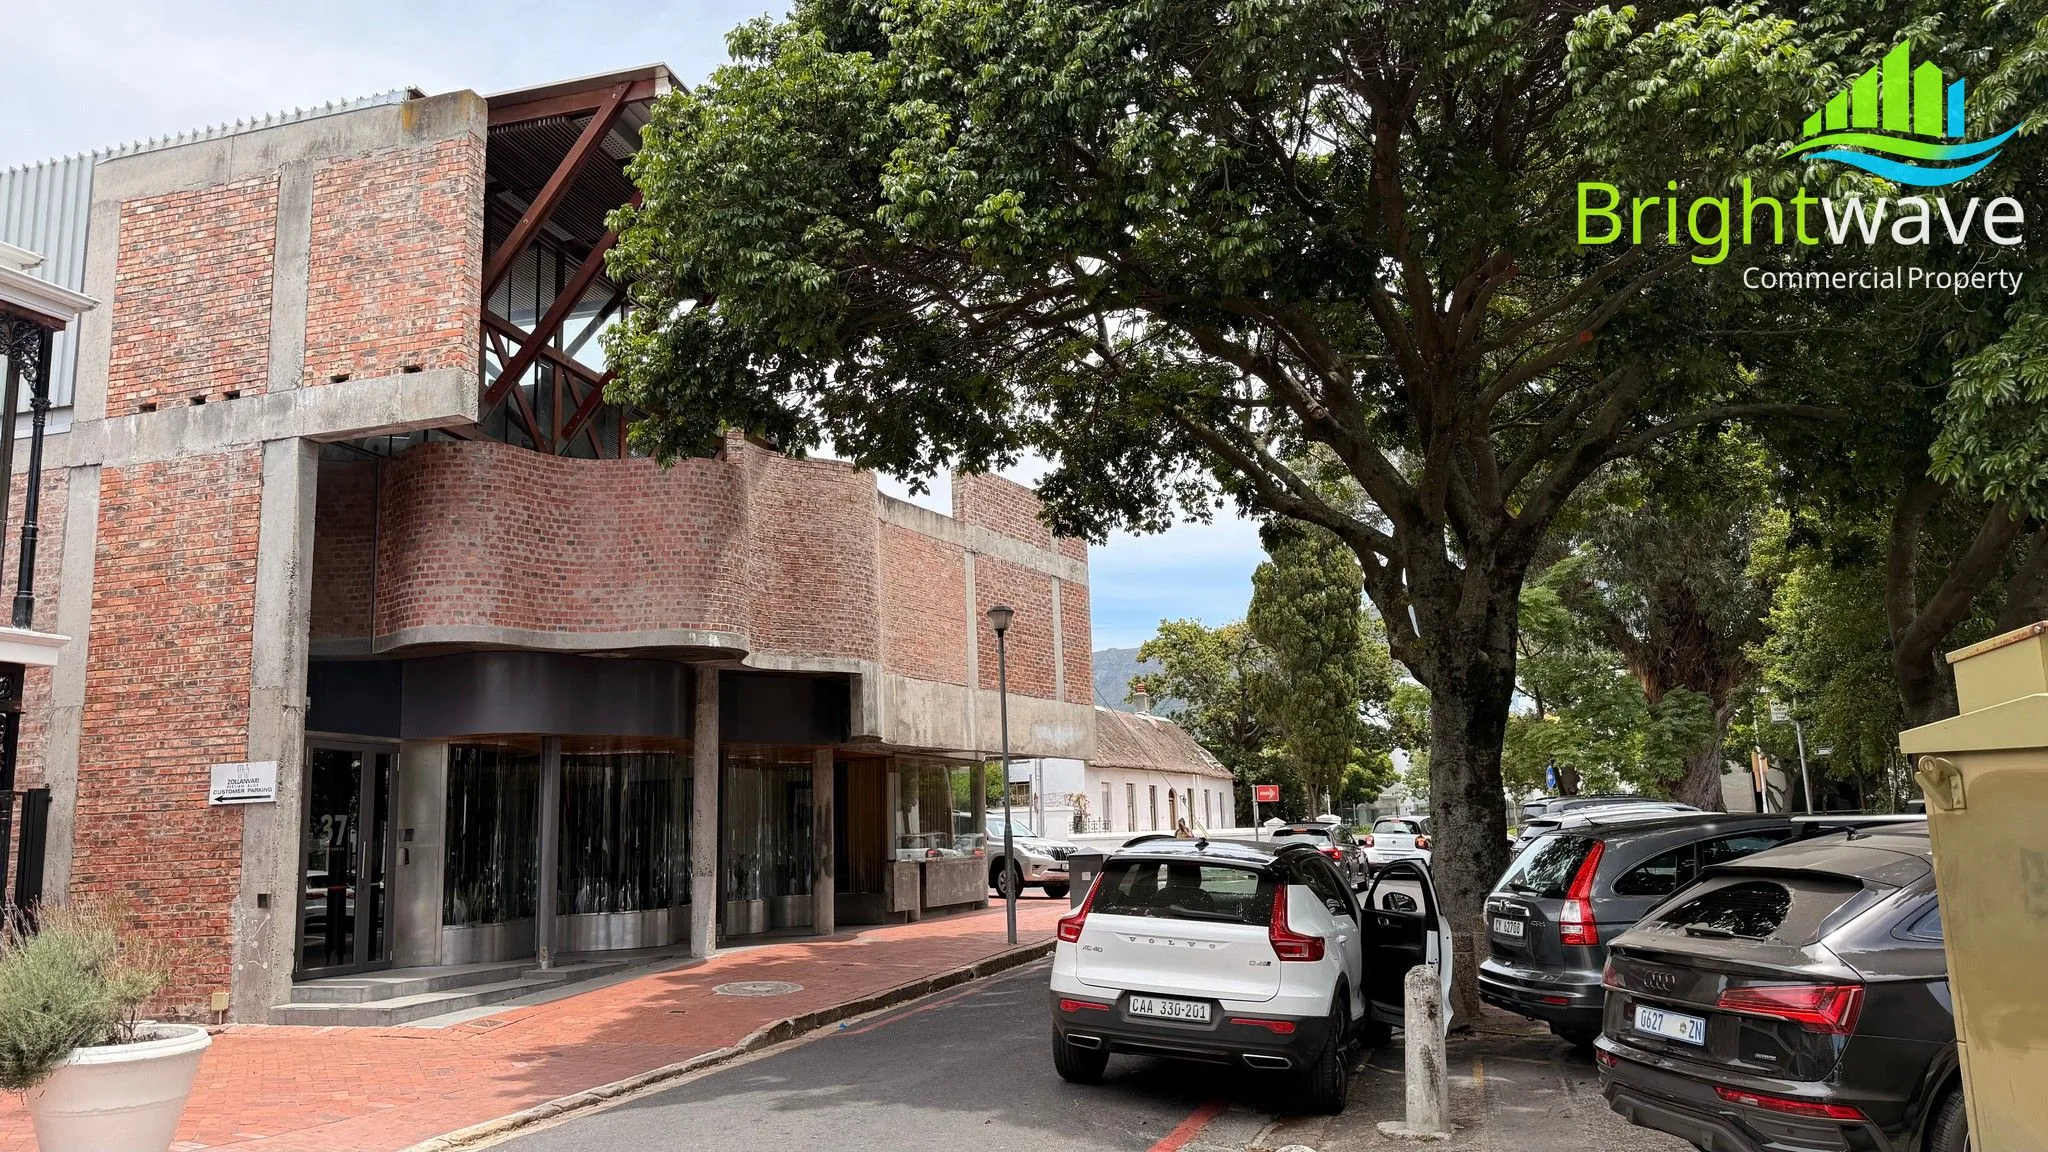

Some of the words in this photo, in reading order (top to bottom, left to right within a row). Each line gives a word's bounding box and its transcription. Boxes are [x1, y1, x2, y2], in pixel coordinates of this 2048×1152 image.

[320, 814, 348, 846] 37
[1128, 936, 1217, 949] VOLVO
[1132, 998, 1153, 1014] CAA
[1160, 1001, 1206, 1019] 330-201
[1640, 1010, 1664, 1031] 0627
[1688, 1019, 1703, 1041] ZN
